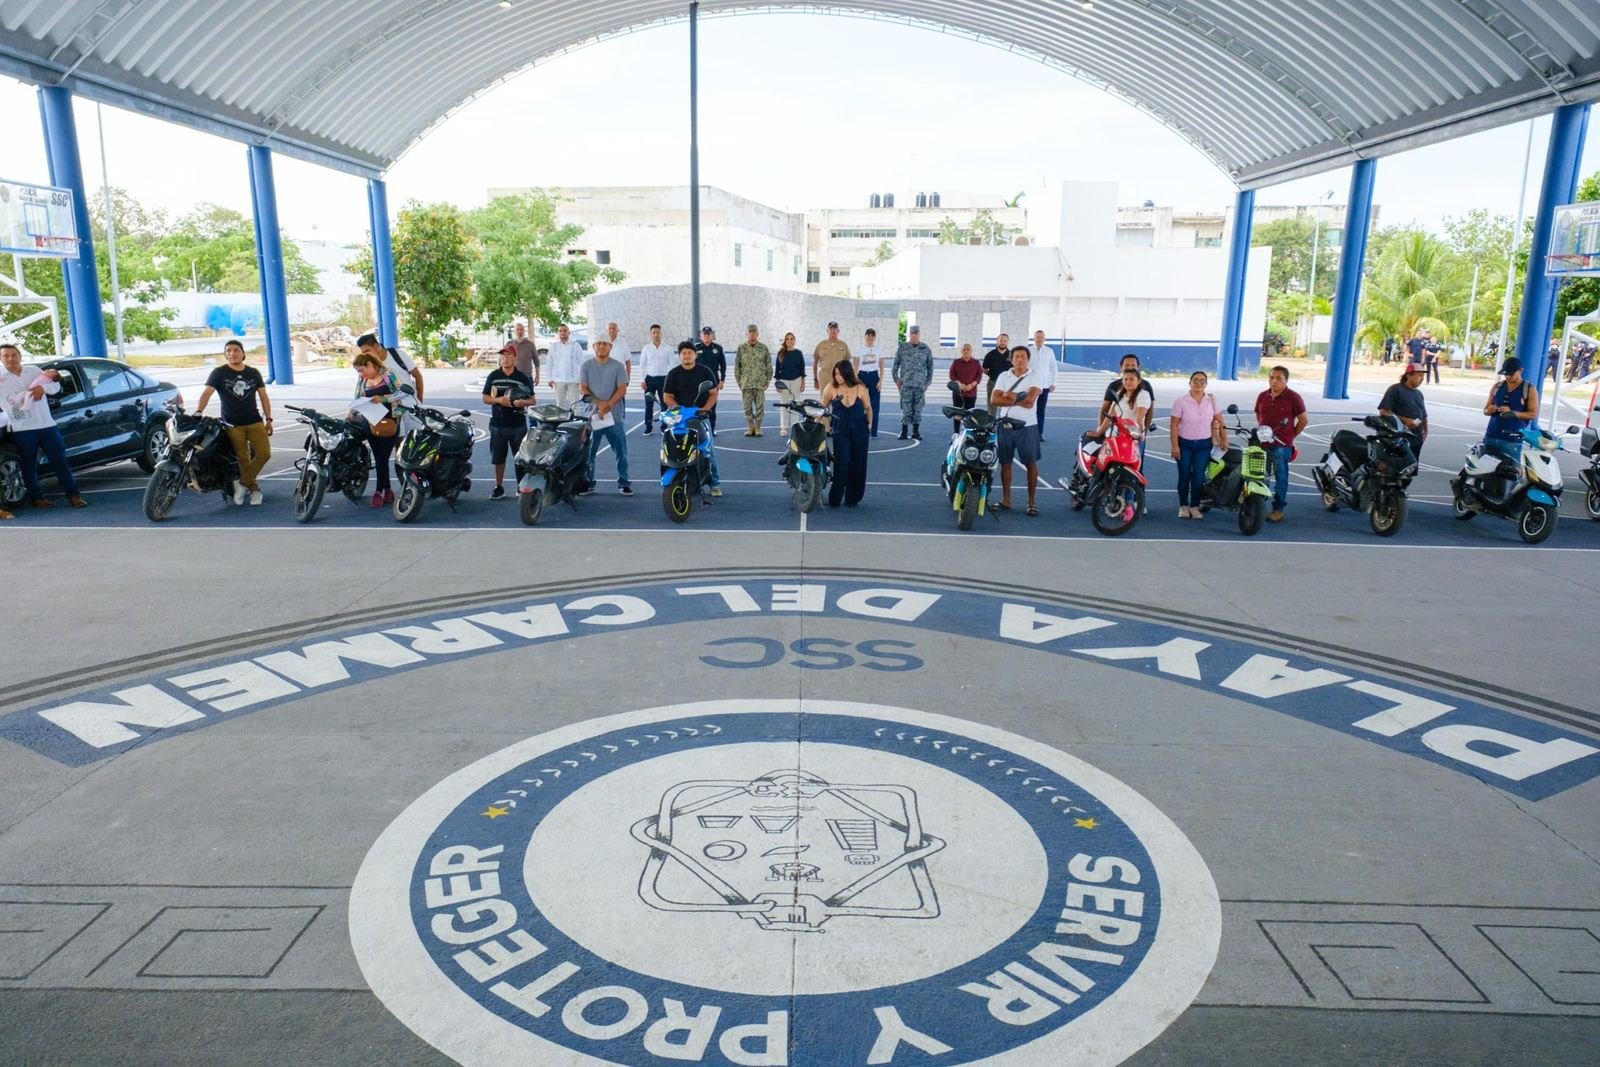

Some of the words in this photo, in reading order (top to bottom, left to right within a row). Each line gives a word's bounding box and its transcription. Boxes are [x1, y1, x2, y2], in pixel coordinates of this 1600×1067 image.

[51, 192, 69, 207] SSC
[676, 583, 942, 621] DEL
[699, 636, 924, 672] SSC
[37, 595, 656, 749] CARMEN
[1000, 603, 1600, 781] PLAYA
[424, 844, 791, 1066] PROTEGER
[959, 853, 1143, 1026] SERVIR
[868, 1005, 953, 1065] Y
